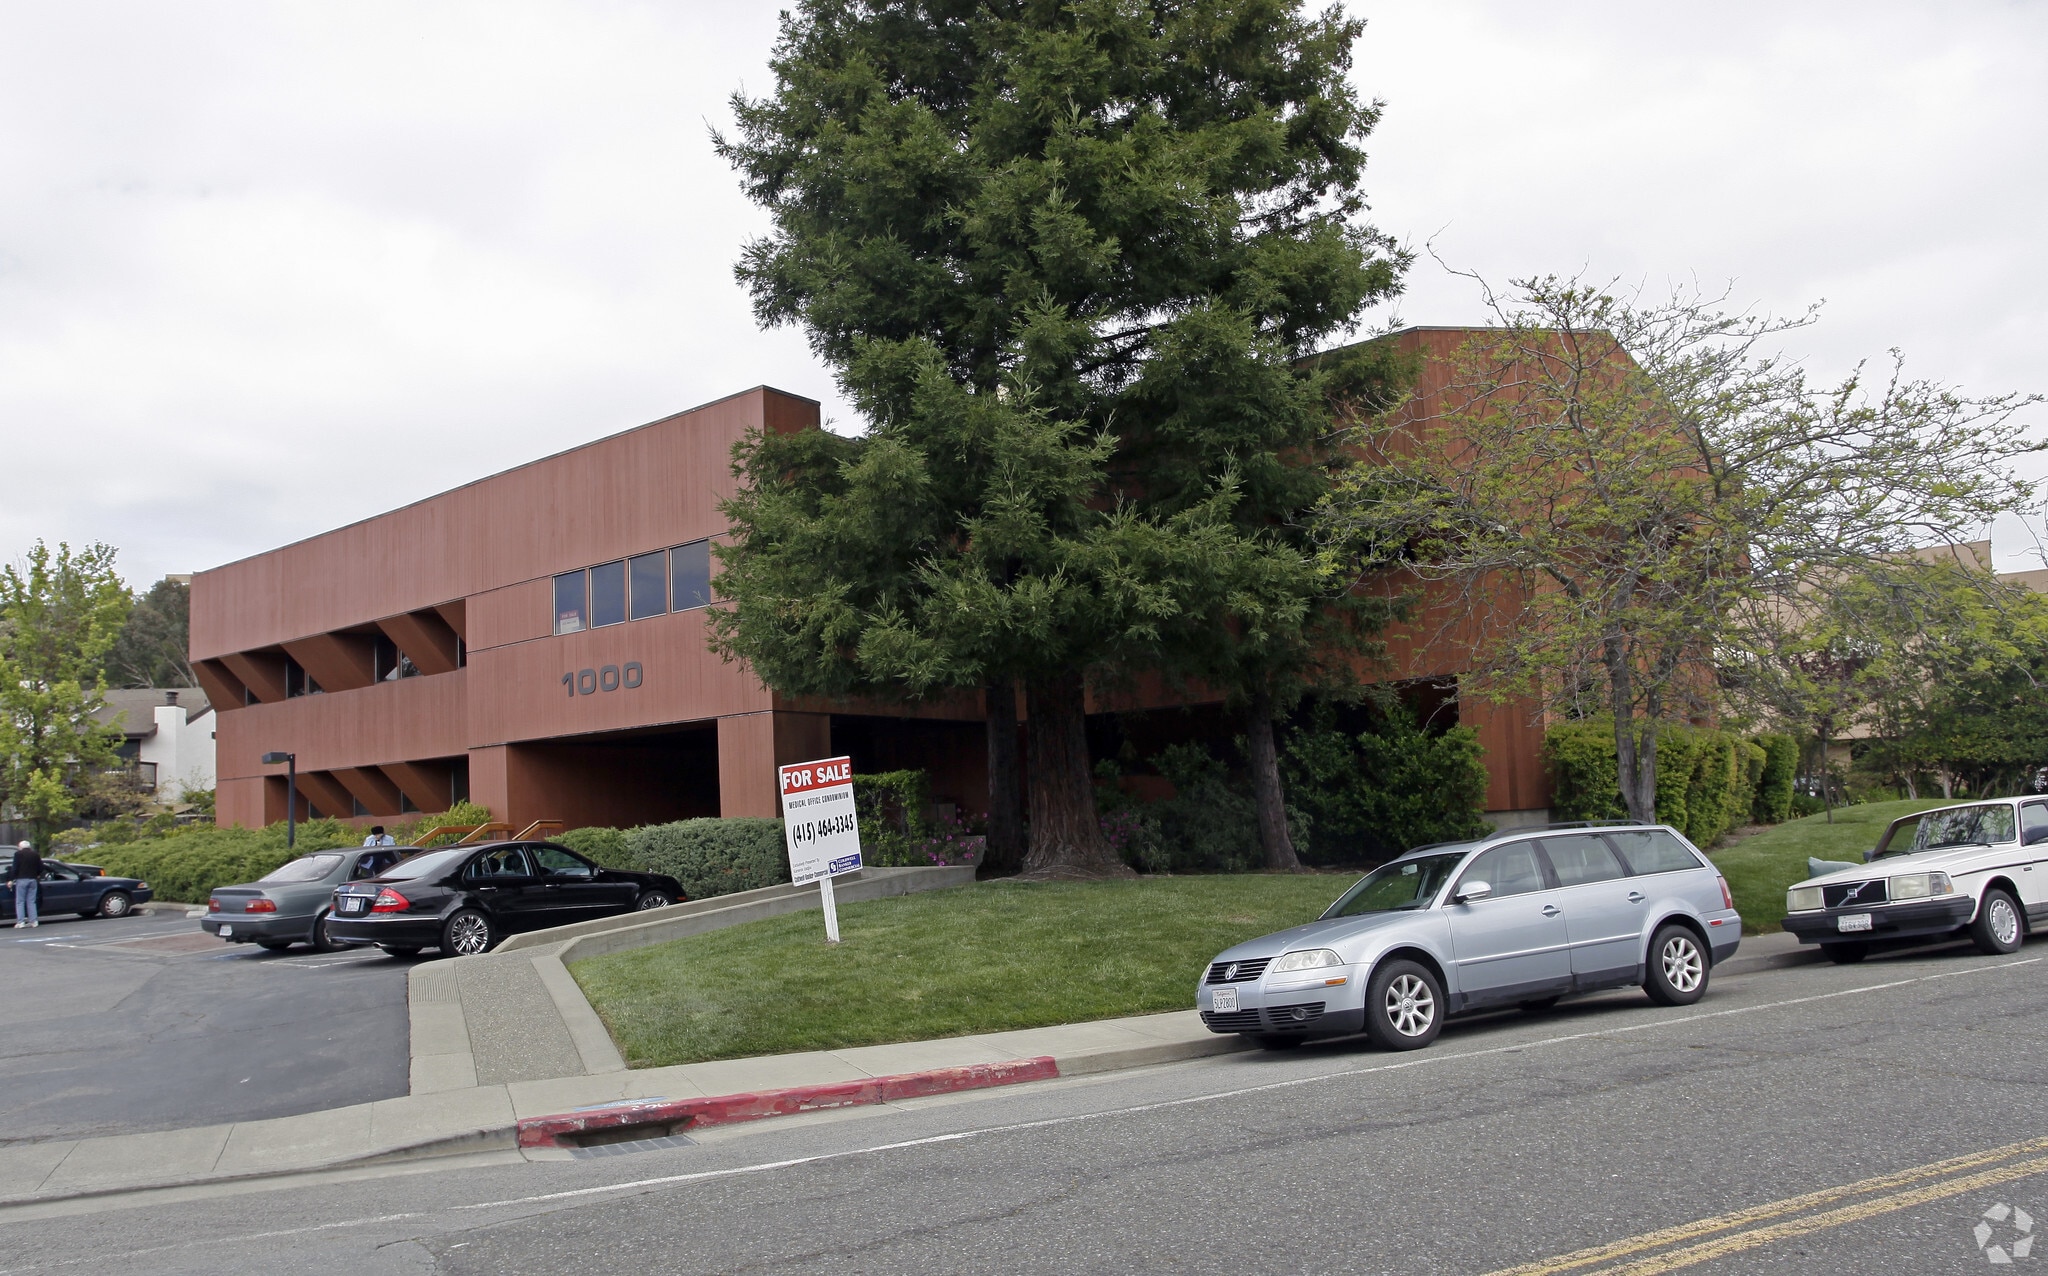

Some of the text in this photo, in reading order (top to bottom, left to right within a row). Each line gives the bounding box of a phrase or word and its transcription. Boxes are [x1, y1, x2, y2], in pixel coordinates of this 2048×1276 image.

[561, 661, 643, 697] 1000
[782, 763, 851, 790] FOR SALE
[788, 799, 807, 810] MEDICAL
[807, 796, 821, 806] OFFICE
[793, 813, 854, 849] (415) 464-3345
